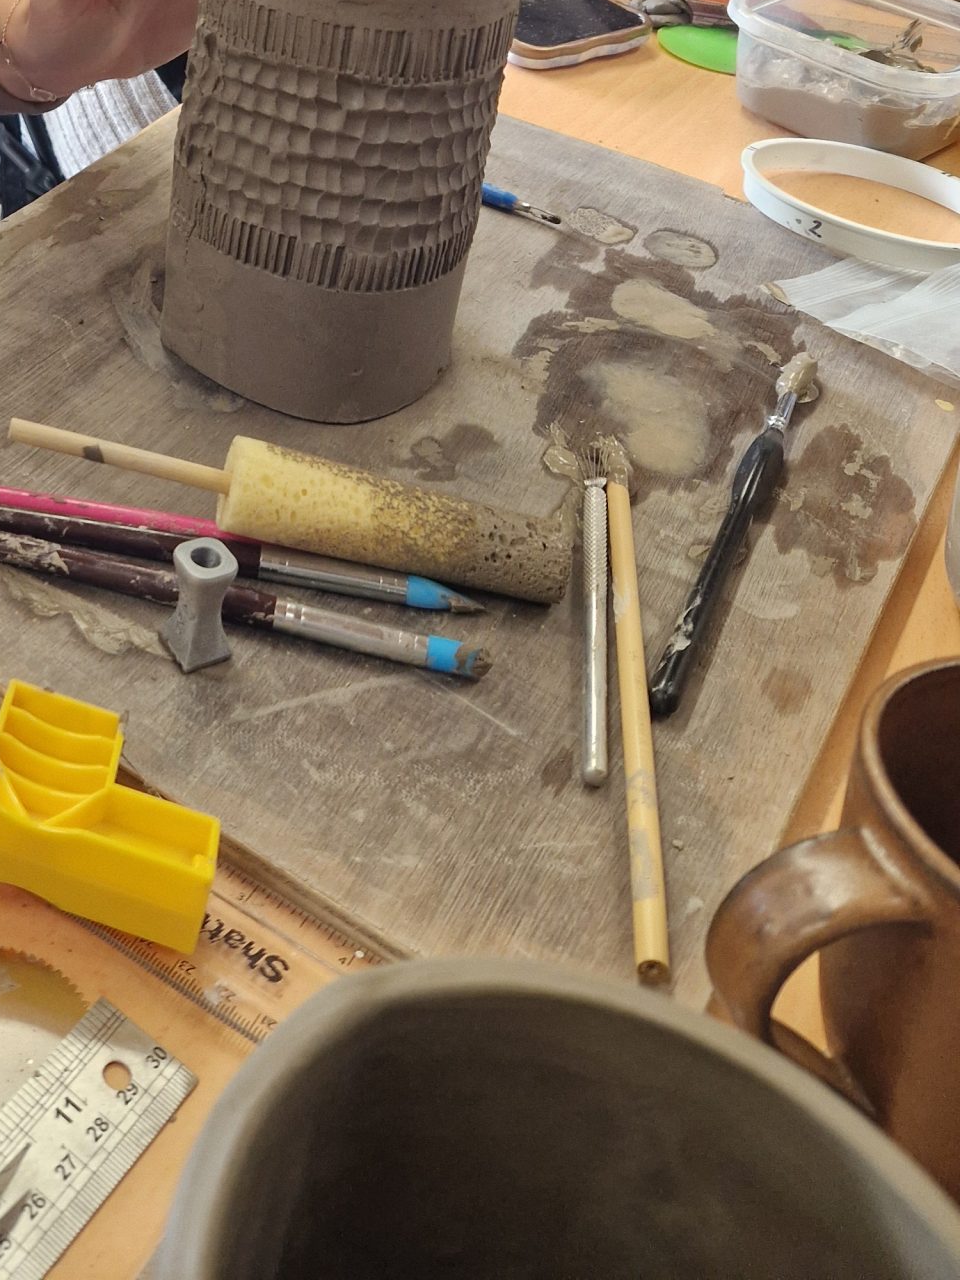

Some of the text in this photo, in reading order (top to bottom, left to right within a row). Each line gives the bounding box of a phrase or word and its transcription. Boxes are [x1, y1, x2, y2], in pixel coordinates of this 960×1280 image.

[808, 219, 822, 238] 2
[145, 1046, 168, 1069] 30
[116, 1083, 140, 1105] 29
[55, 1096, 83, 1124] 11
[86, 1117, 111, 1143] 28
[54, 1153, 77, 1181] 27
[23, 1192, 47, 1221] 26
